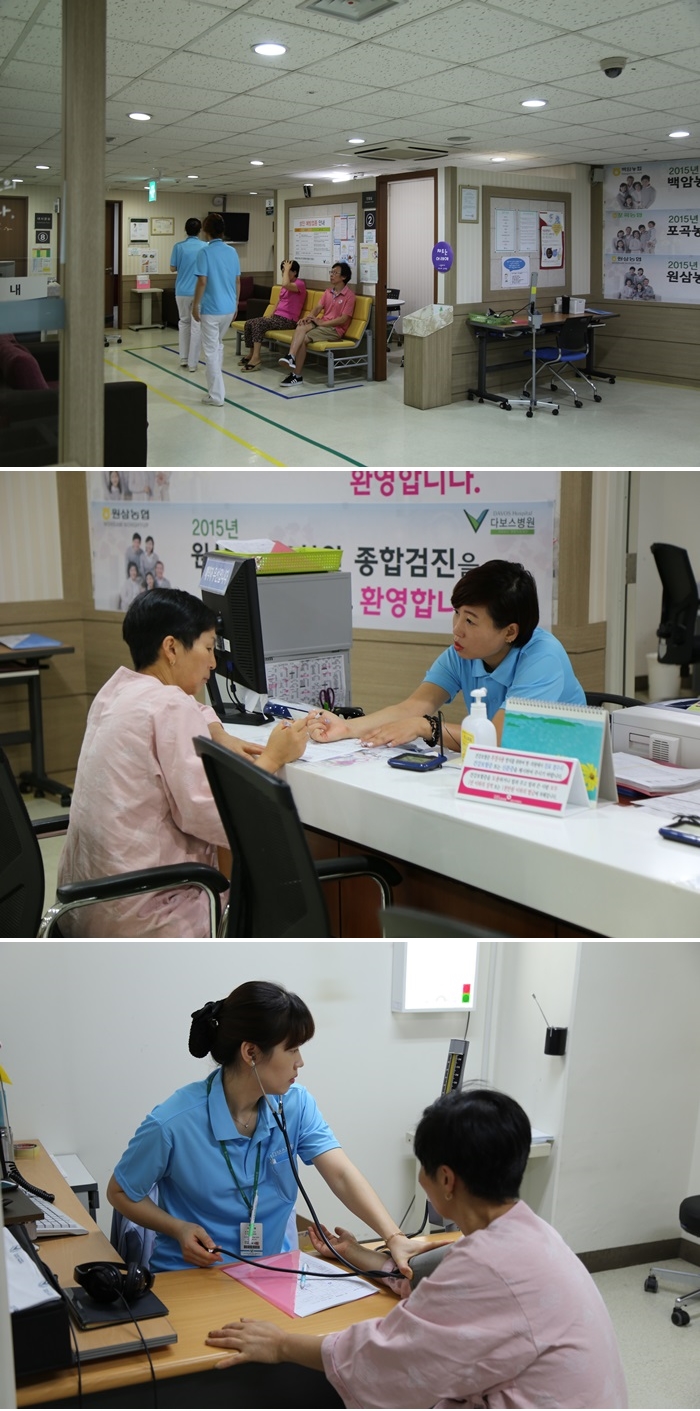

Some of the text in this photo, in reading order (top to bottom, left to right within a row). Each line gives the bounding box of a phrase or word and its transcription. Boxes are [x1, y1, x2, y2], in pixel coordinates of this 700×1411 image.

[669, 165, 699, 175] 2015년
[668, 215, 699, 224] 2015년
[668, 261, 698, 270] 2015년
[10, 284, 21, 295] 내
[350, 471, 481, 497] 환영합니다.
[112, 508, 150, 521] 원삼농협
[192, 518, 238, 539] 2015년
[490, 516, 535, 529] 다보스병원
[354, 547, 479, 578] 종합검진을
